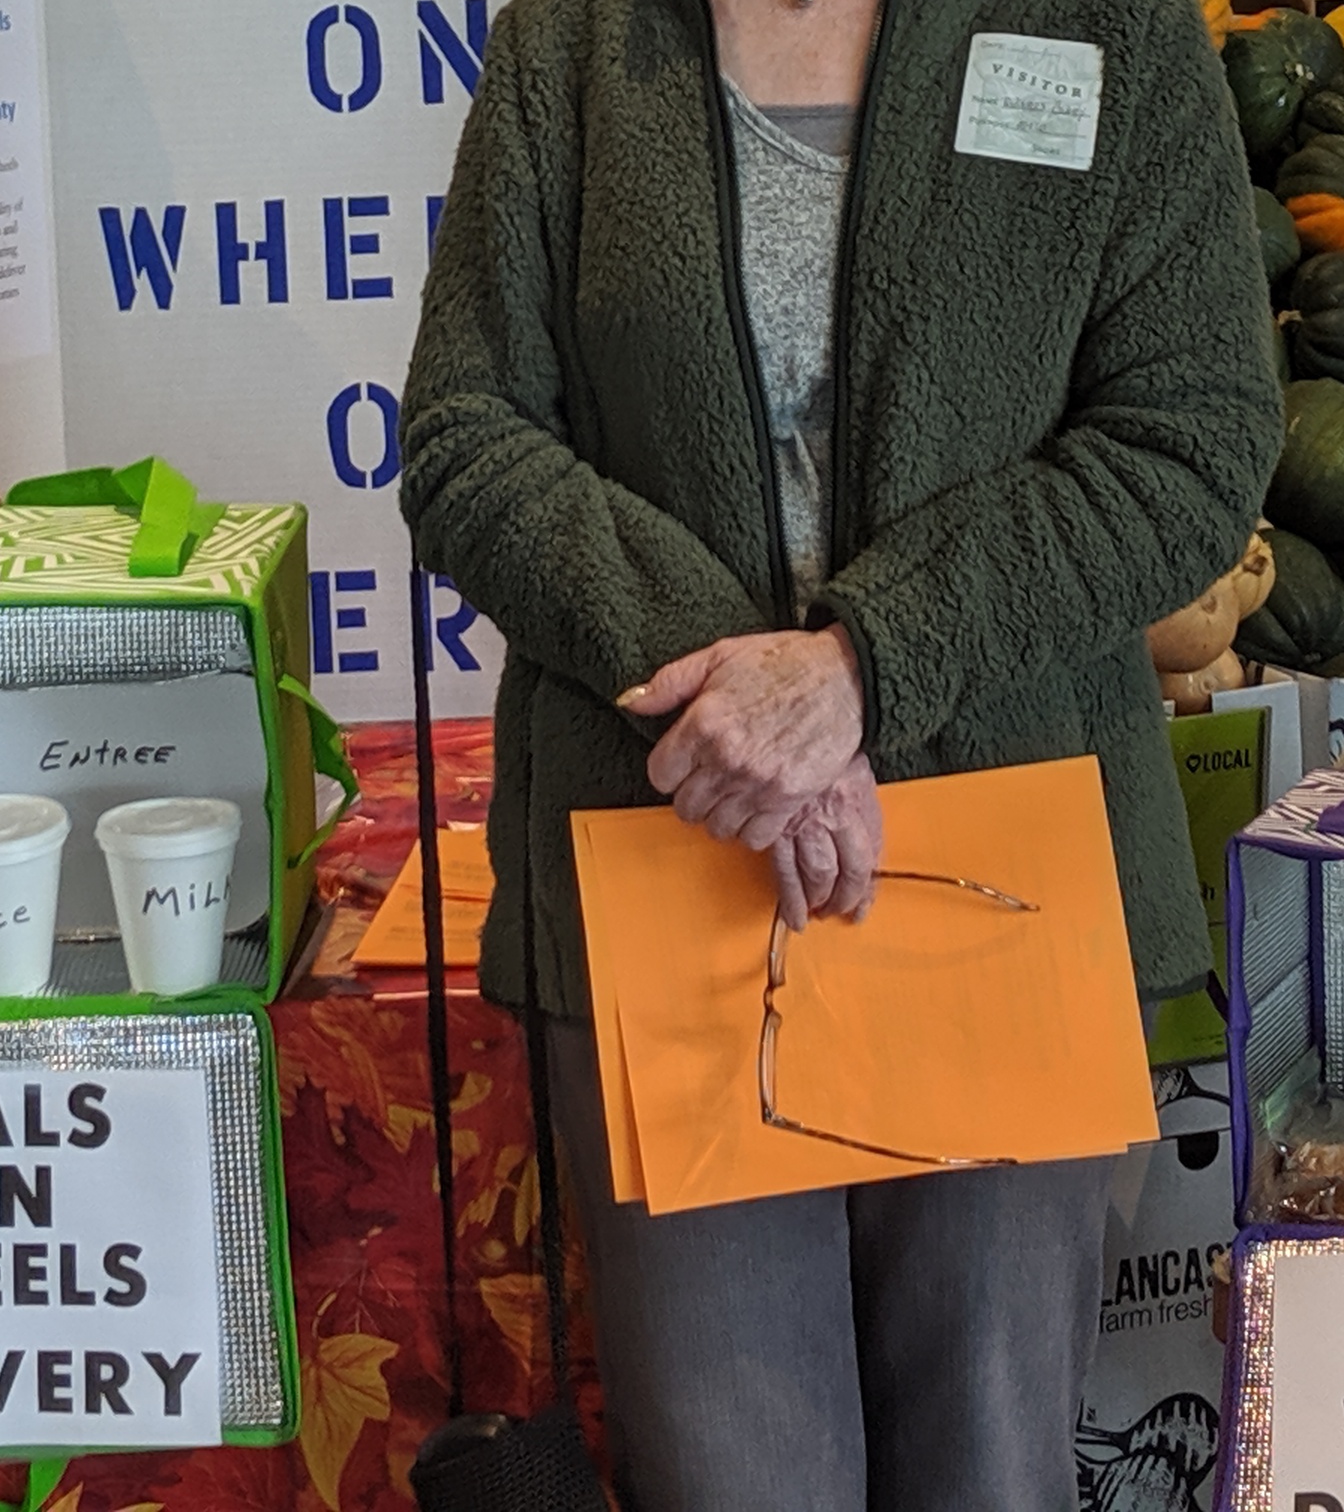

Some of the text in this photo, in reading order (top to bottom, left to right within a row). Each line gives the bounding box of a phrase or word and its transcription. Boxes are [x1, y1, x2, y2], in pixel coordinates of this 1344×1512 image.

[992, 63, 1083, 98] VISITOR
[99, 196, 446, 311] WHE
[1202, 749, 1252, 773] LOCAL
[1099, 1308, 1153, 1334] farm
